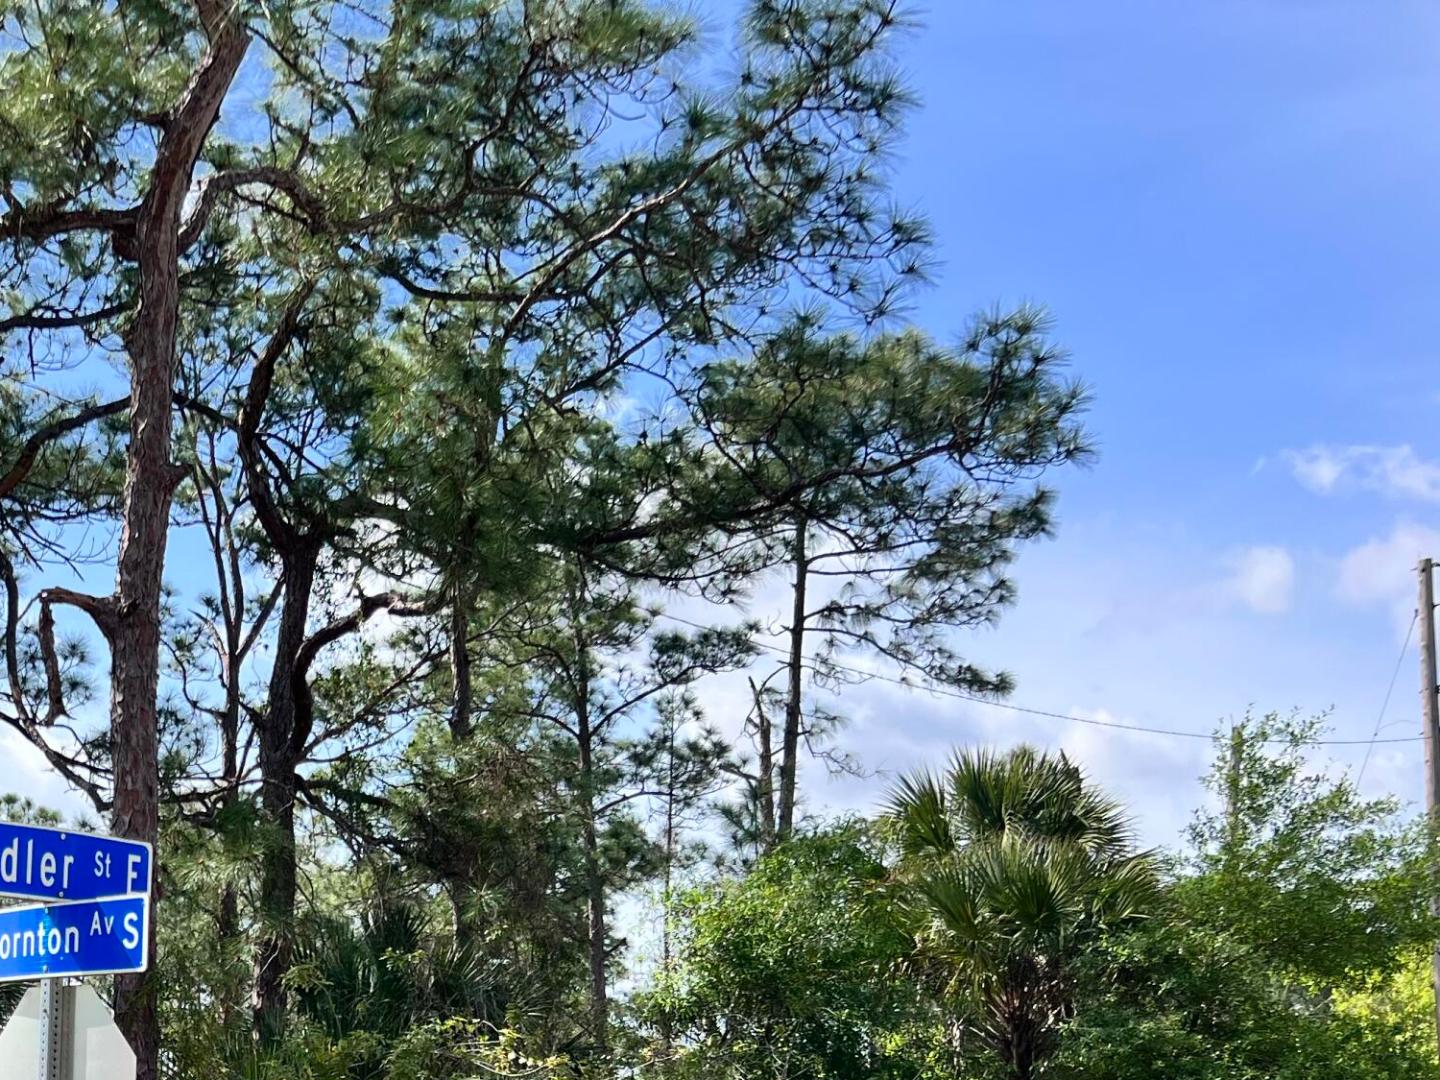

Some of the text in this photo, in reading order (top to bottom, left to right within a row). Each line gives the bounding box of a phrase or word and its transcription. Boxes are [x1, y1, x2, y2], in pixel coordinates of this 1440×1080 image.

[93, 850, 111, 878] St
[89, 910, 115, 937] Av
[122, 912, 139, 950] S
